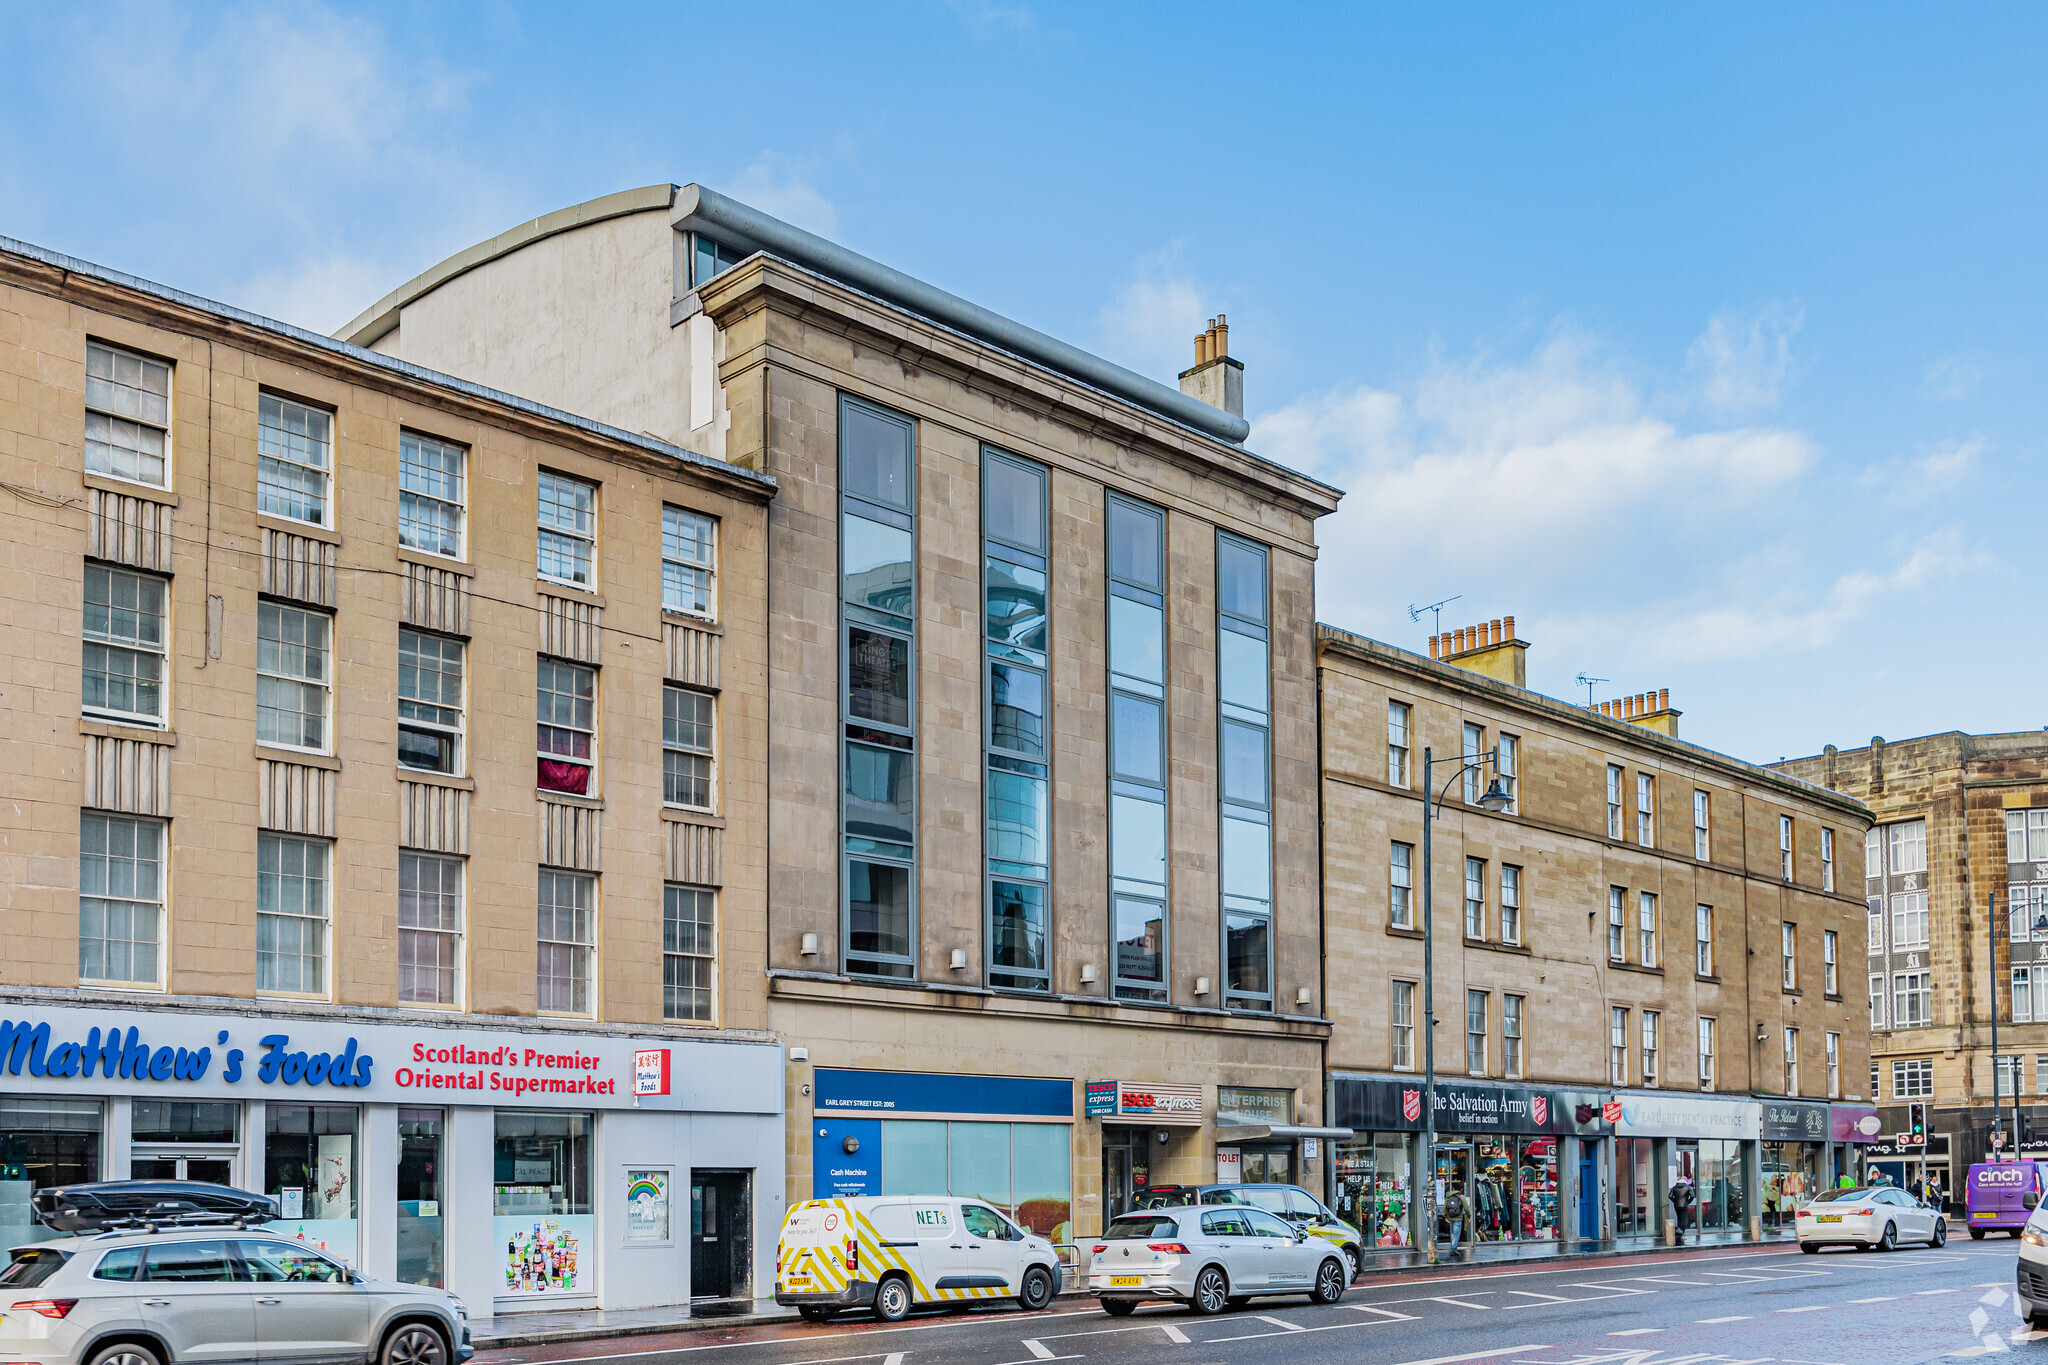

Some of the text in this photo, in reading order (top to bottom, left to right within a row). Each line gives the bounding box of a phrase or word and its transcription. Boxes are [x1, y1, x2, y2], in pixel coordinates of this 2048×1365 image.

[0, 1019, 374, 1087] Matthew's Foods
[412, 1043, 600, 1070] Scotland's Premier
[637, 1071, 660, 1080] Matthew's
[395, 1067, 615, 1096] Oriental Supermarket
[641, 1082, 656, 1091] Foods
[1087, 1083, 1116, 1092] TESCO
[825, 1098, 839, 1106] EARL
[1088, 1095, 1115, 1104] express
[1122, 1093, 1196, 1112] ESCO express
[1220, 1094, 1286, 1107] ENTERPRISE
[1425, 1091, 1528, 1118] he Salvation Army
[1236, 1109, 1272, 1120] HOUSE
[1458, 1112, 1498, 1124] belief in action
[1641, 1111, 1742, 1127] EARL GREY DENTAL PRACTICE
[1768, 1108, 1779, 1123] The
[1217, 1153, 1239, 1162] TO LET
[1347, 1160, 1373, 1168] BE A STAR
[830, 1168, 844, 1176] Cash
[1978, 1167, 2023, 1182] cinch
[650, 1173, 664, 1188] YOU
[1347, 1174, 1371, 1183] HELP US
[1380, 1181, 1394, 1189] HELP
